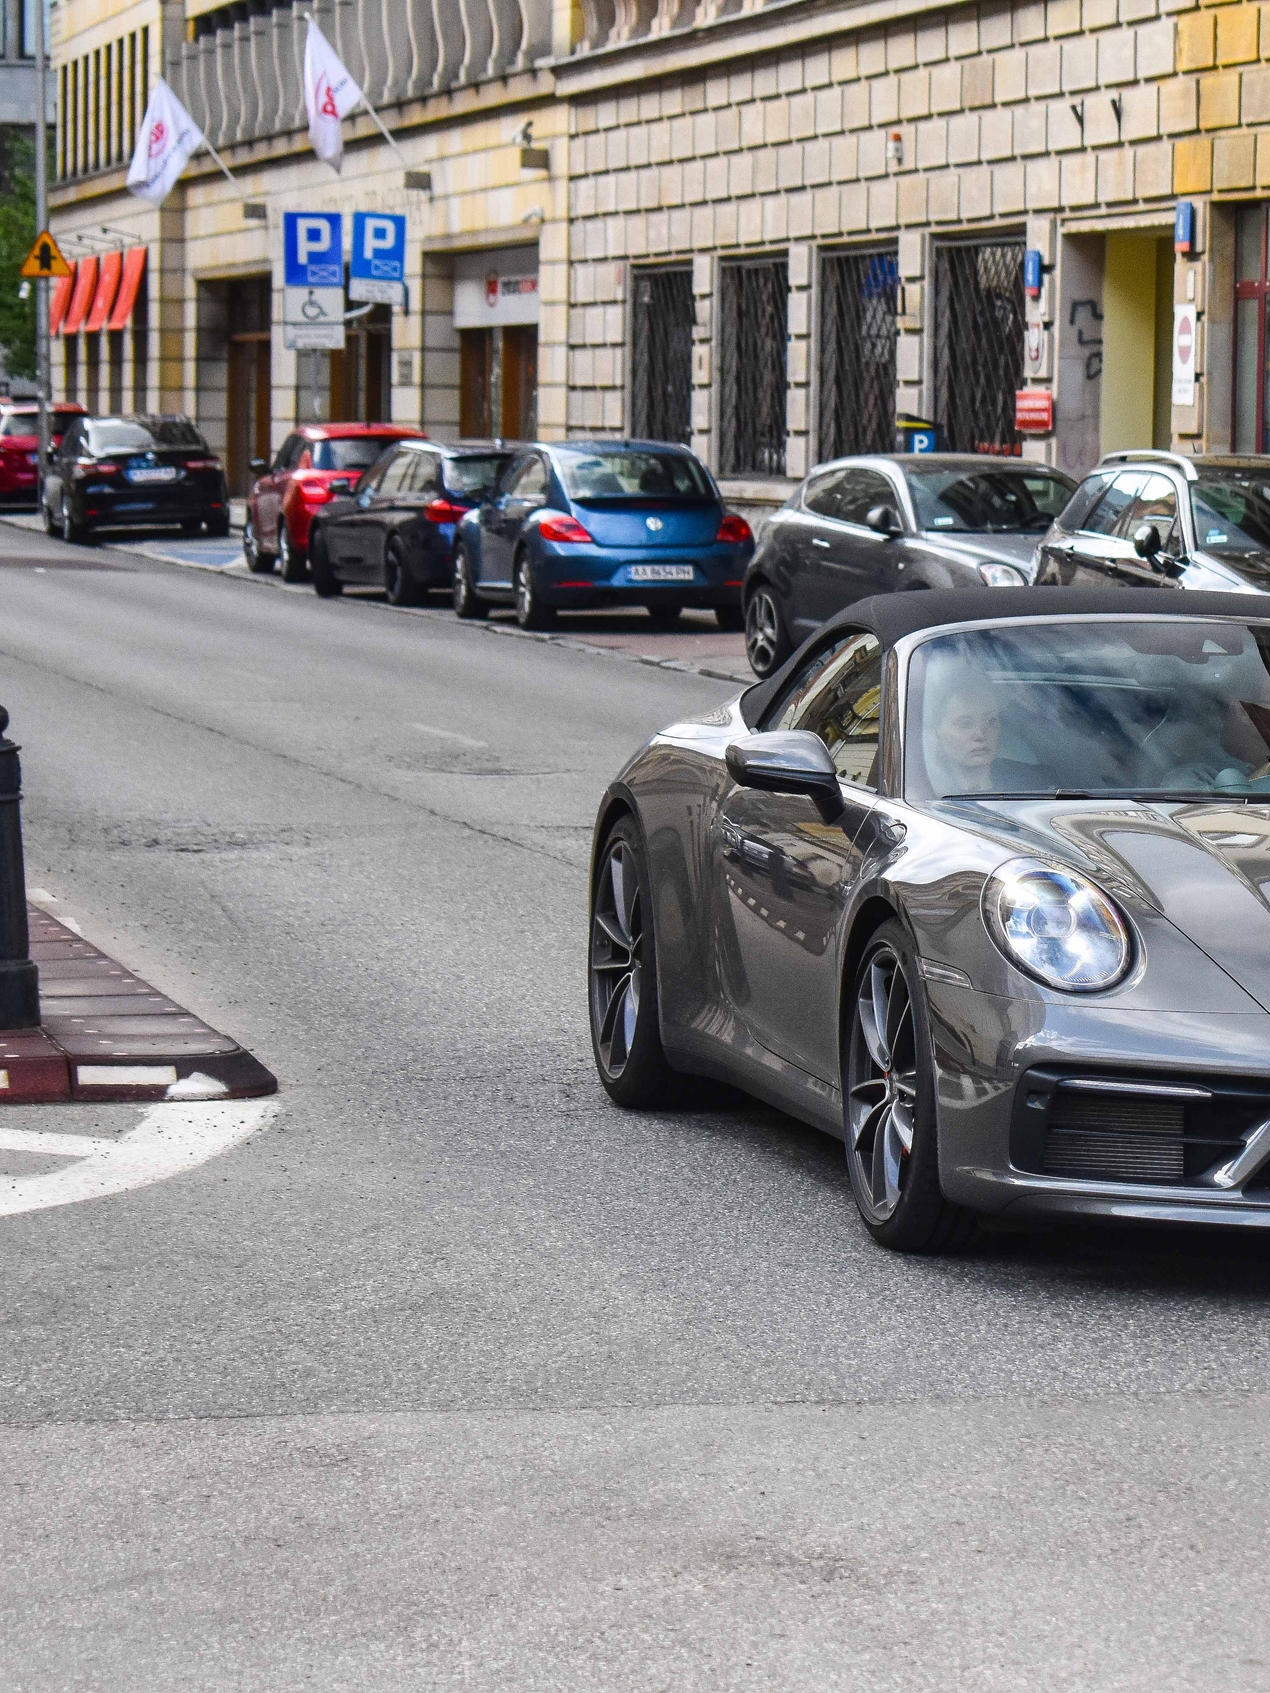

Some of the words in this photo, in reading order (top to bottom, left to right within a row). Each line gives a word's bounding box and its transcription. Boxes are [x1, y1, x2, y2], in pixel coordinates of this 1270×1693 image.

[296, 217, 331, 265] P
[363, 217, 396, 260] P
[914, 434, 929, 454] P
